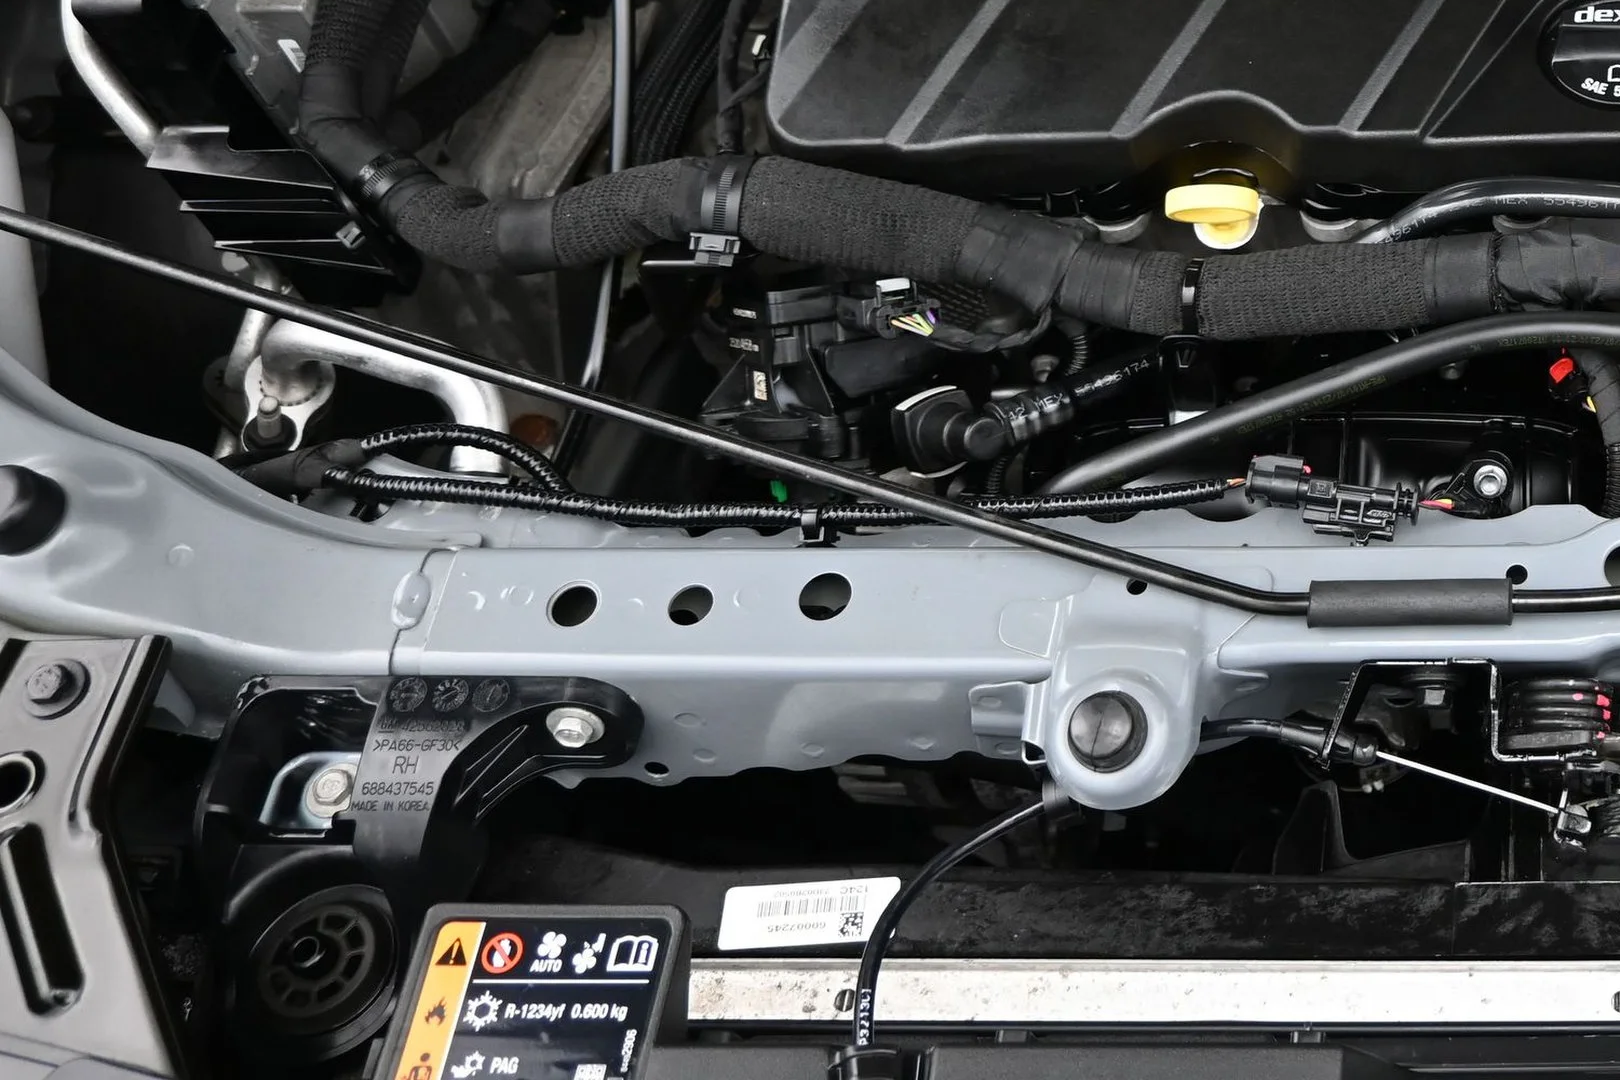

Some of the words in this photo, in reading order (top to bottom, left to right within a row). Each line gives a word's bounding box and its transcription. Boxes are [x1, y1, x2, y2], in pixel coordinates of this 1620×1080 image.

[1581, 77, 1609, 95] SAE
[392, 756, 420, 774] RH
[362, 782, 434, 796] 688437545
[351, 800, 379, 812] MADE
[383, 801, 394, 811] IN
[399, 800, 431, 812] KOREA
[529, 958, 563, 973] AUTO
[504, 1003, 567, 1021] R-1234yf
[571, 1003, 609, 1019] 0.600
[610, 1003, 628, 1022] kg
[490, 1056, 519, 1074] PAG
